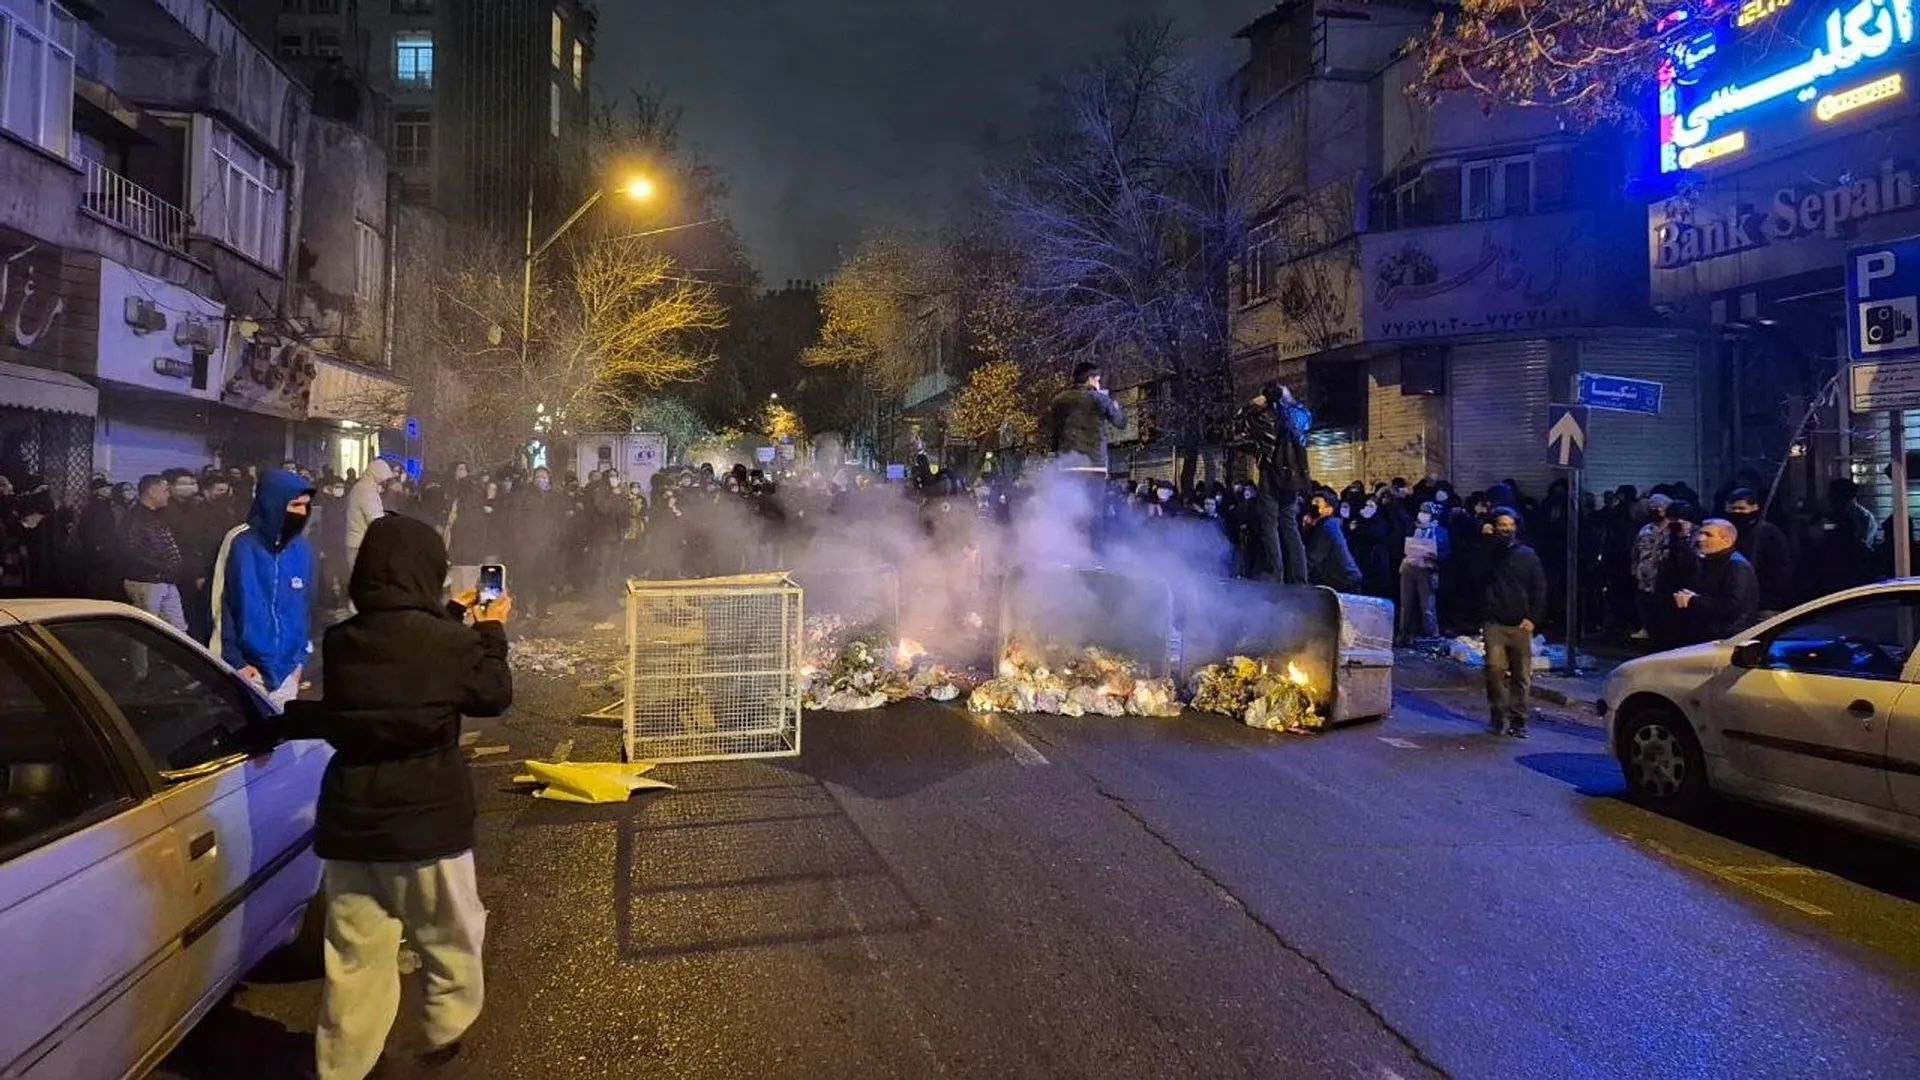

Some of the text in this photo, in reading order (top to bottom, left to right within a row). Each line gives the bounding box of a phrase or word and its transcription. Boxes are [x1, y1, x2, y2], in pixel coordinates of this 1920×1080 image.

[1655, 159, 1915, 268] Bank Sepah
[1856, 250, 1896, 299] P
